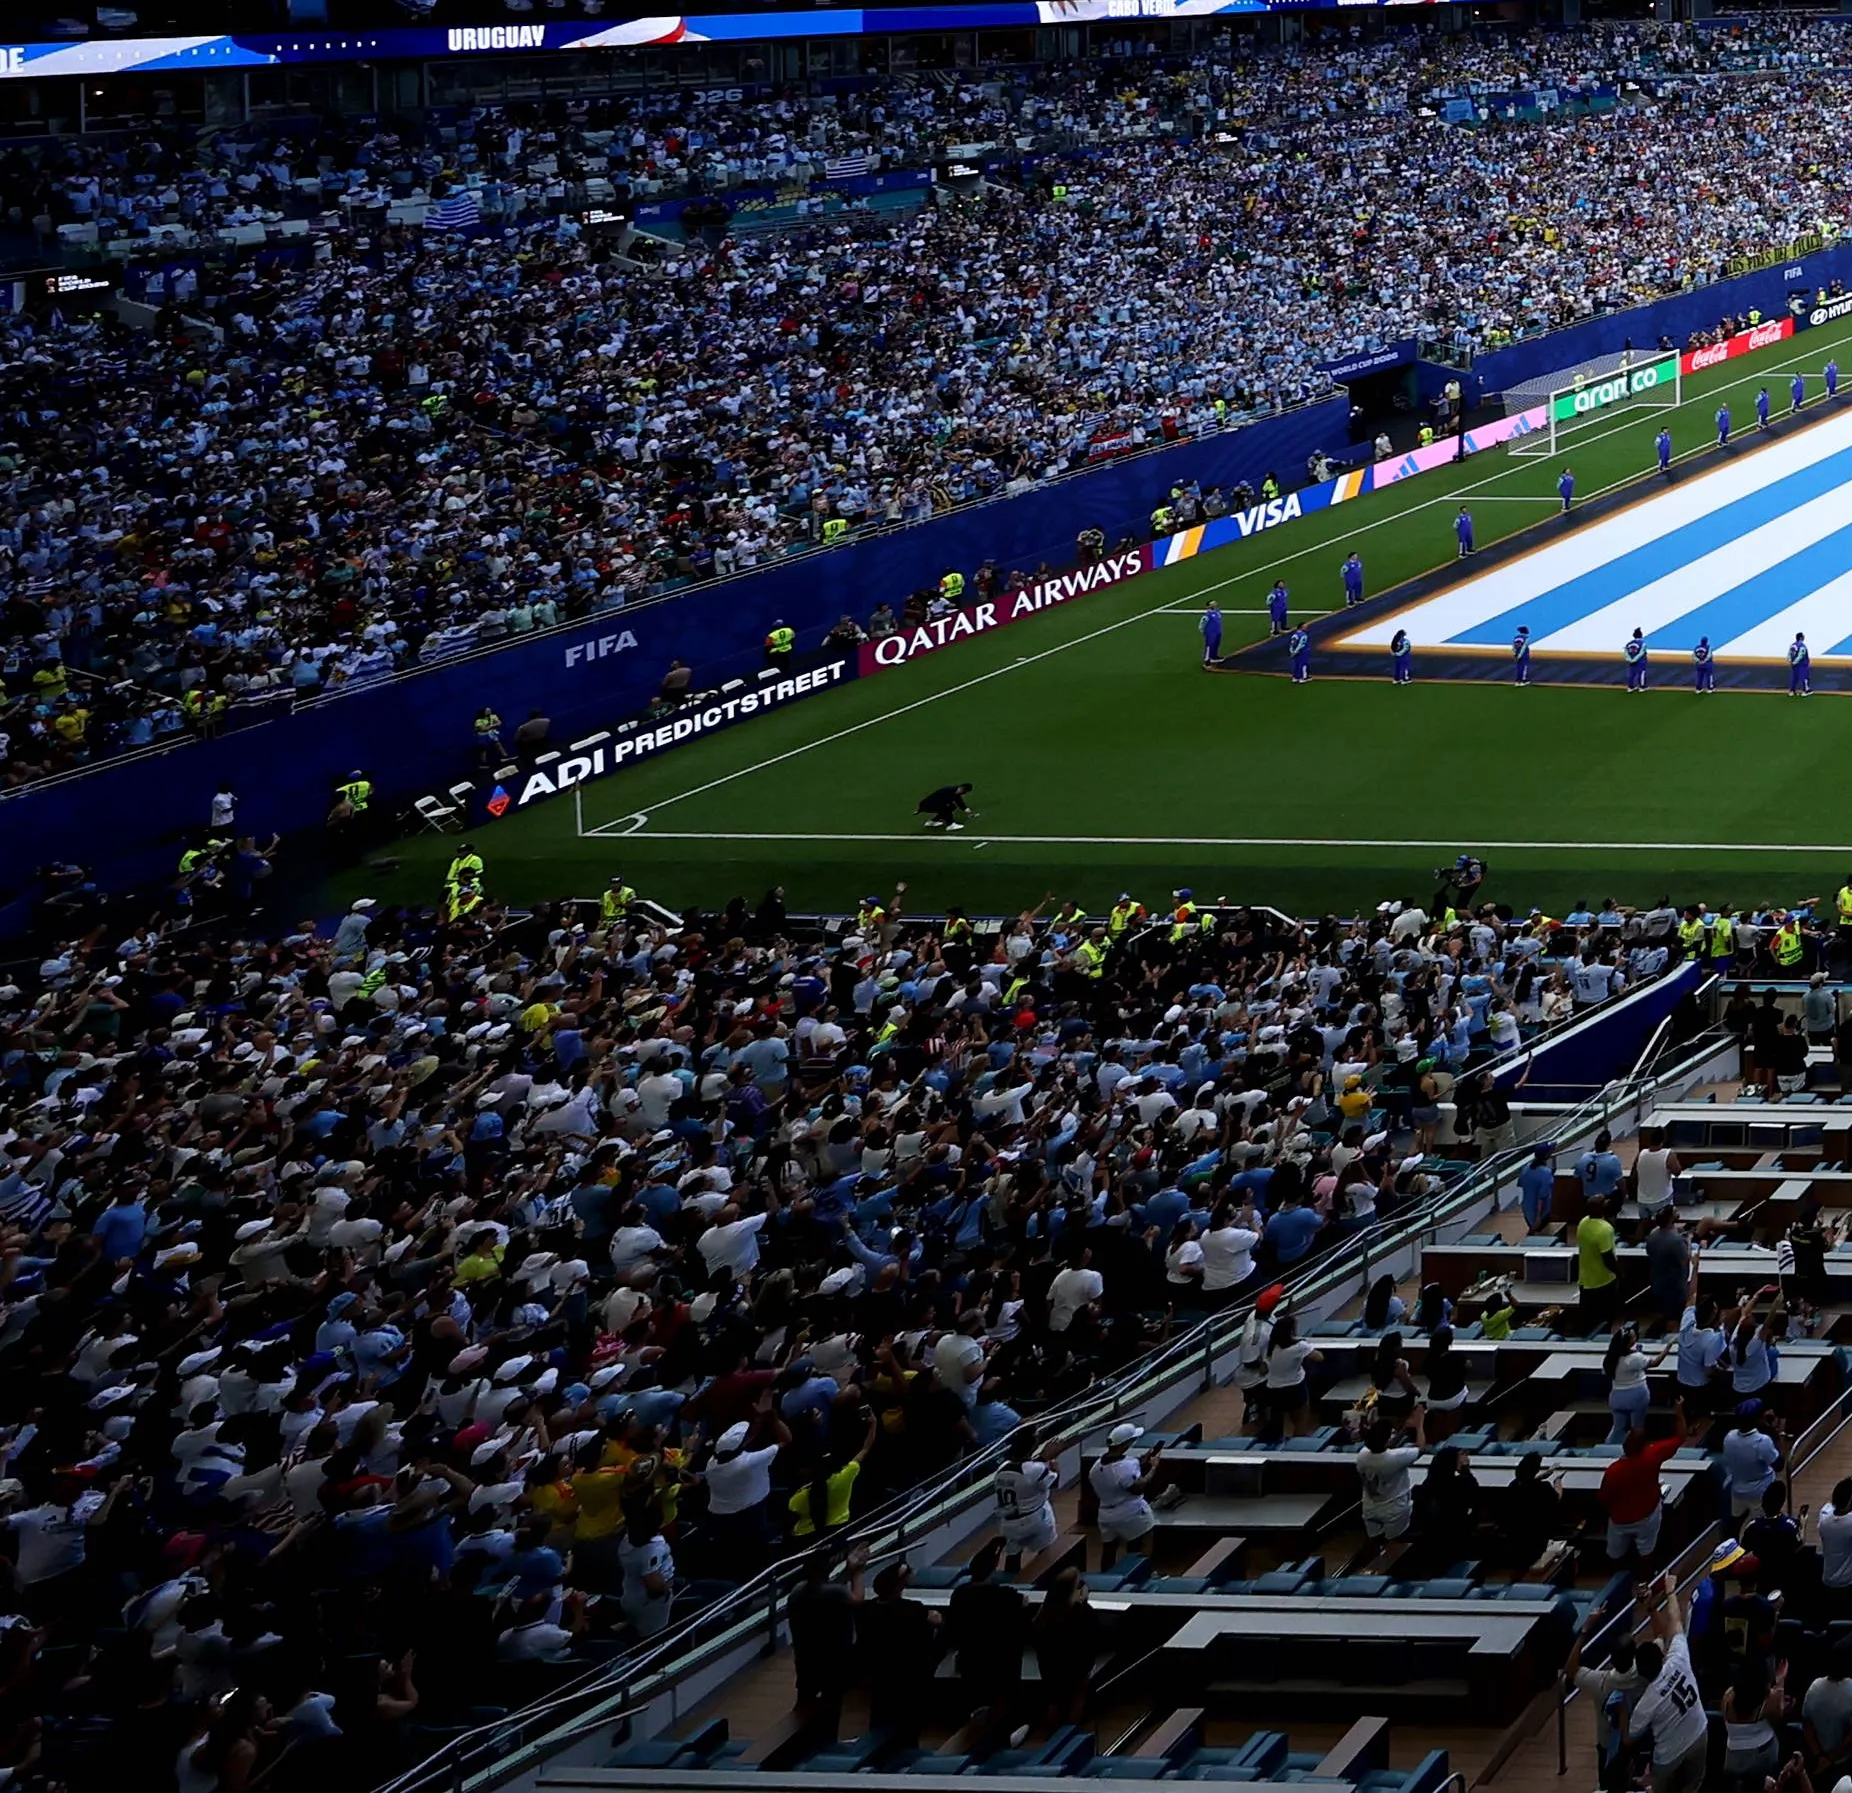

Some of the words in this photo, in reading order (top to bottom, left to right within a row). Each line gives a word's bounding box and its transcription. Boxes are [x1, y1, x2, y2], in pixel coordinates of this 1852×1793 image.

[1108, 0, 1139, 17] CABO
[448, 25, 546, 51] URUGUAY
[1784, 266, 1803, 281] FIFA
[1331, 363, 1357, 376] WORLD
[1359, 359, 1373, 369] CUP
[1231, 493, 1303, 537] VISA
[874, 603, 999, 667] QATAR
[1012, 551, 1143, 617] AIRWAYS
[565, 629, 639, 668] FIFA
[519, 748, 606, 805] ADI
[615, 660, 846, 762] PREDICTSTREET
[1671, 1684, 1699, 1717] 15
